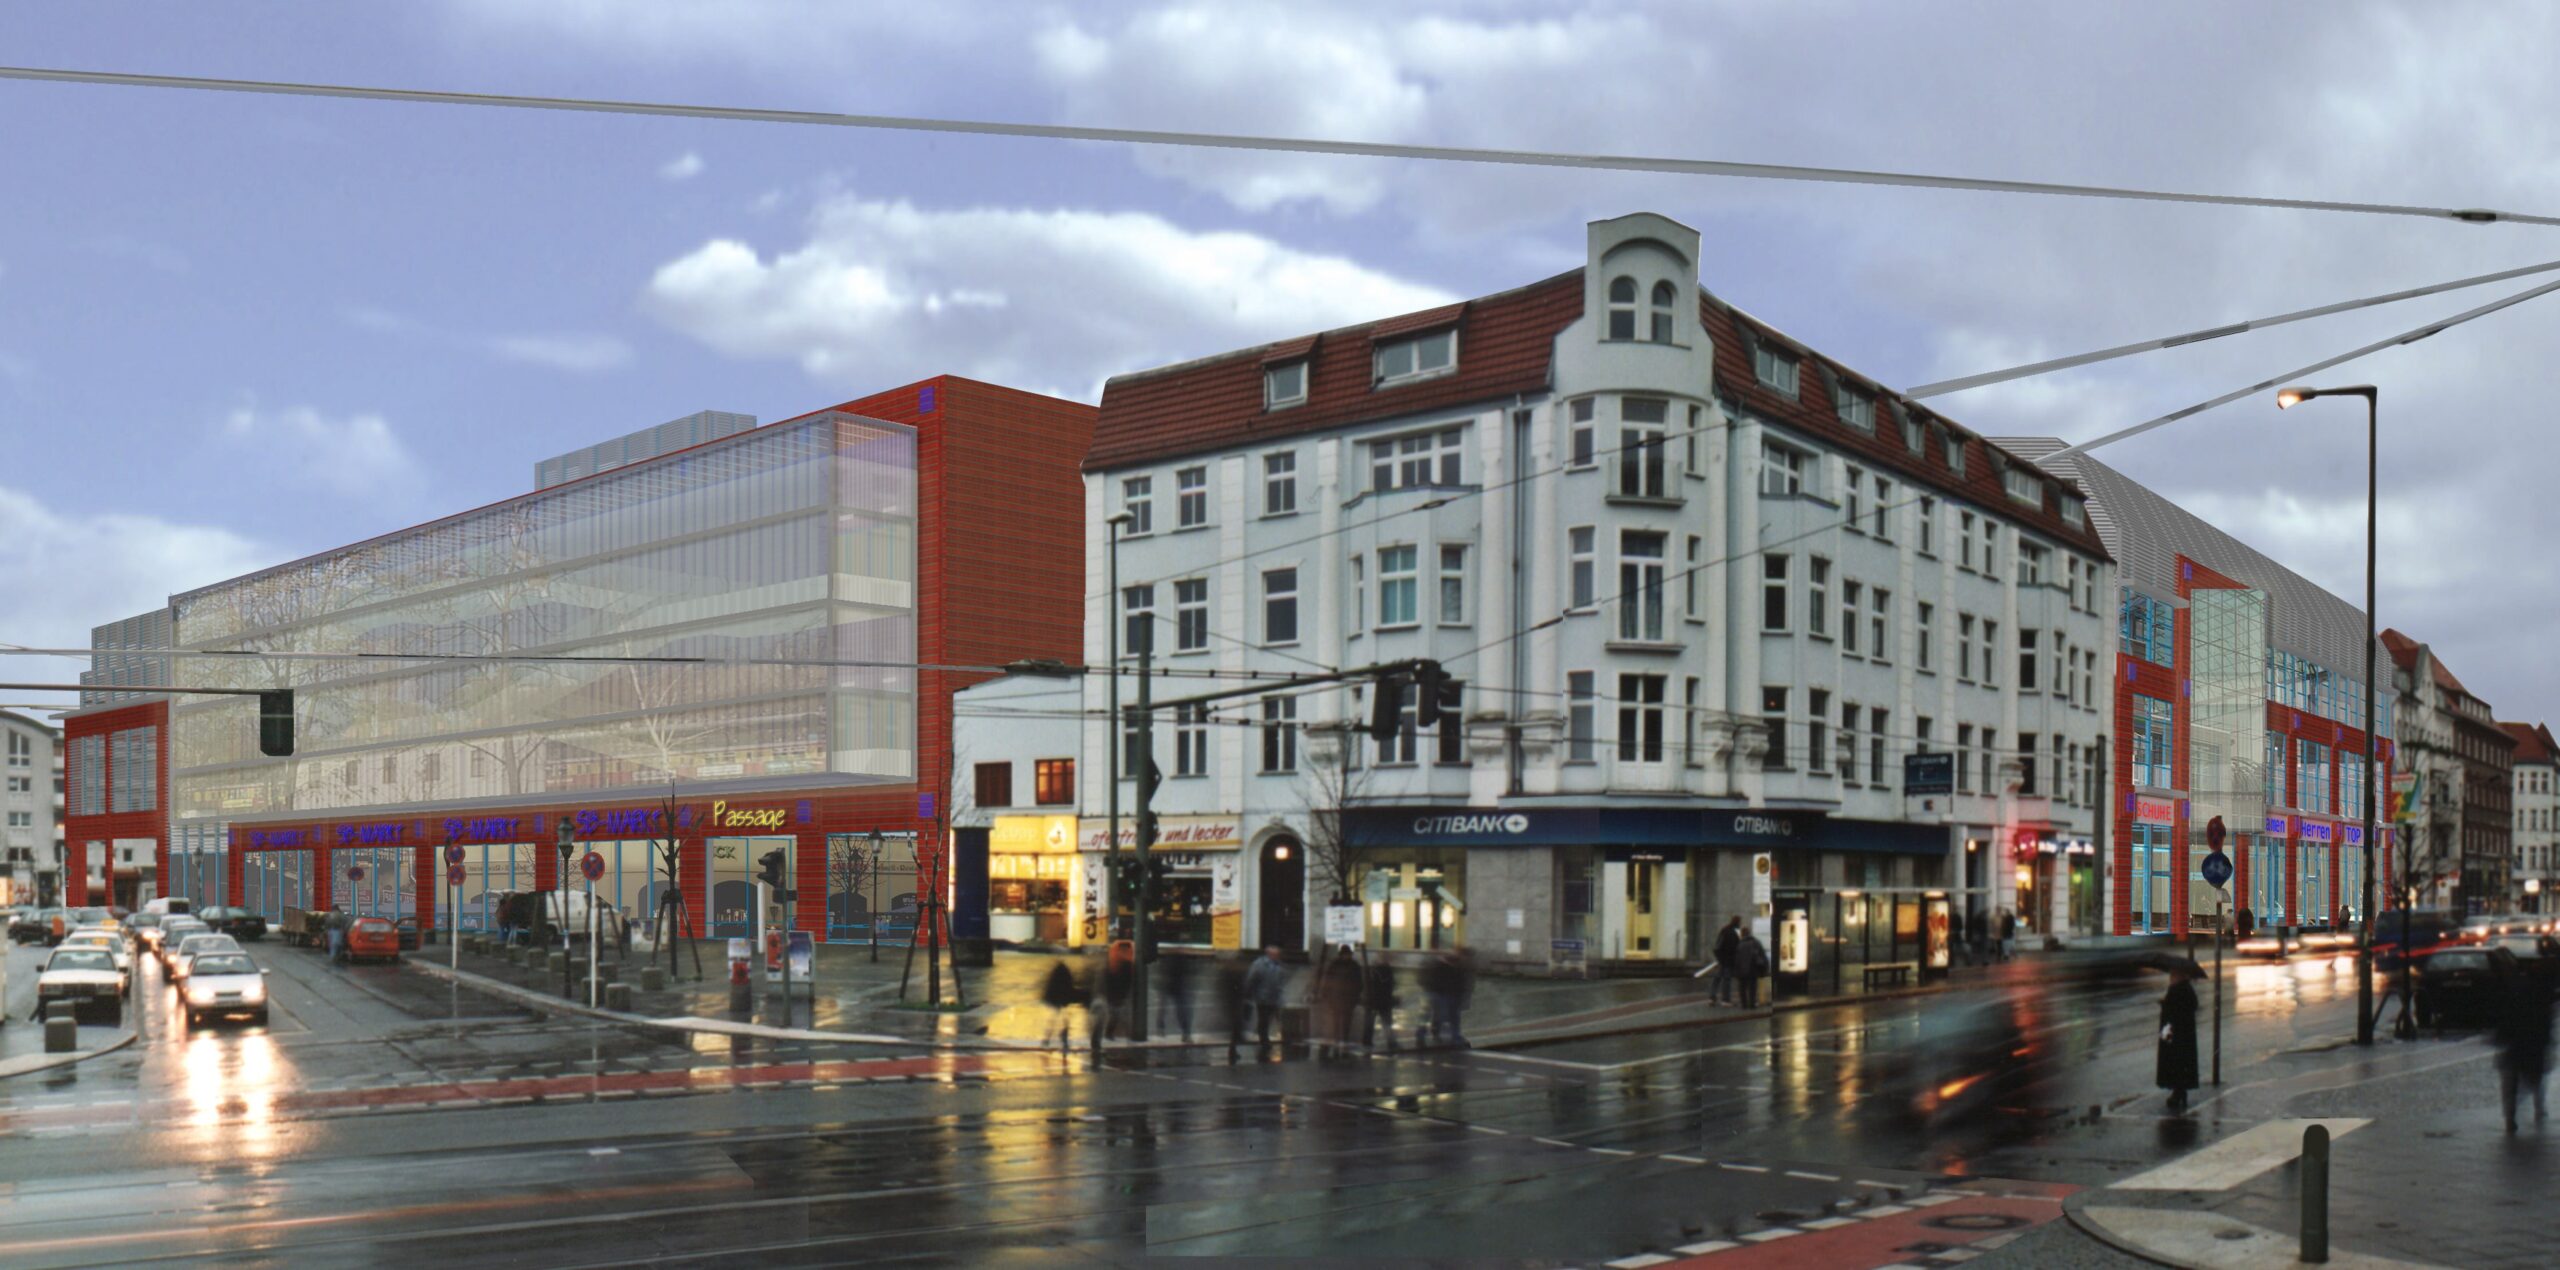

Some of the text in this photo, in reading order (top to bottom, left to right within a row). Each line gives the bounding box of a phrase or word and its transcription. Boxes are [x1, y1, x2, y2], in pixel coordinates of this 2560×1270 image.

[713, 800, 786, 831] Passage
[2137, 802, 2171, 820] SCHUHE
[443, 818, 520, 841] SB-MARKT
[1165, 826, 1191, 842] und
[1193, 824, 1234, 841] lecker
[1414, 815, 1506, 834] CITIBANK
[2266, 817, 2285, 832] amen
[2302, 822, 2330, 839] Herren
[2346, 827, 2361, 842] TOP
[713, 846, 736, 860] CK
[1085, 890, 1098, 939] CAFE
